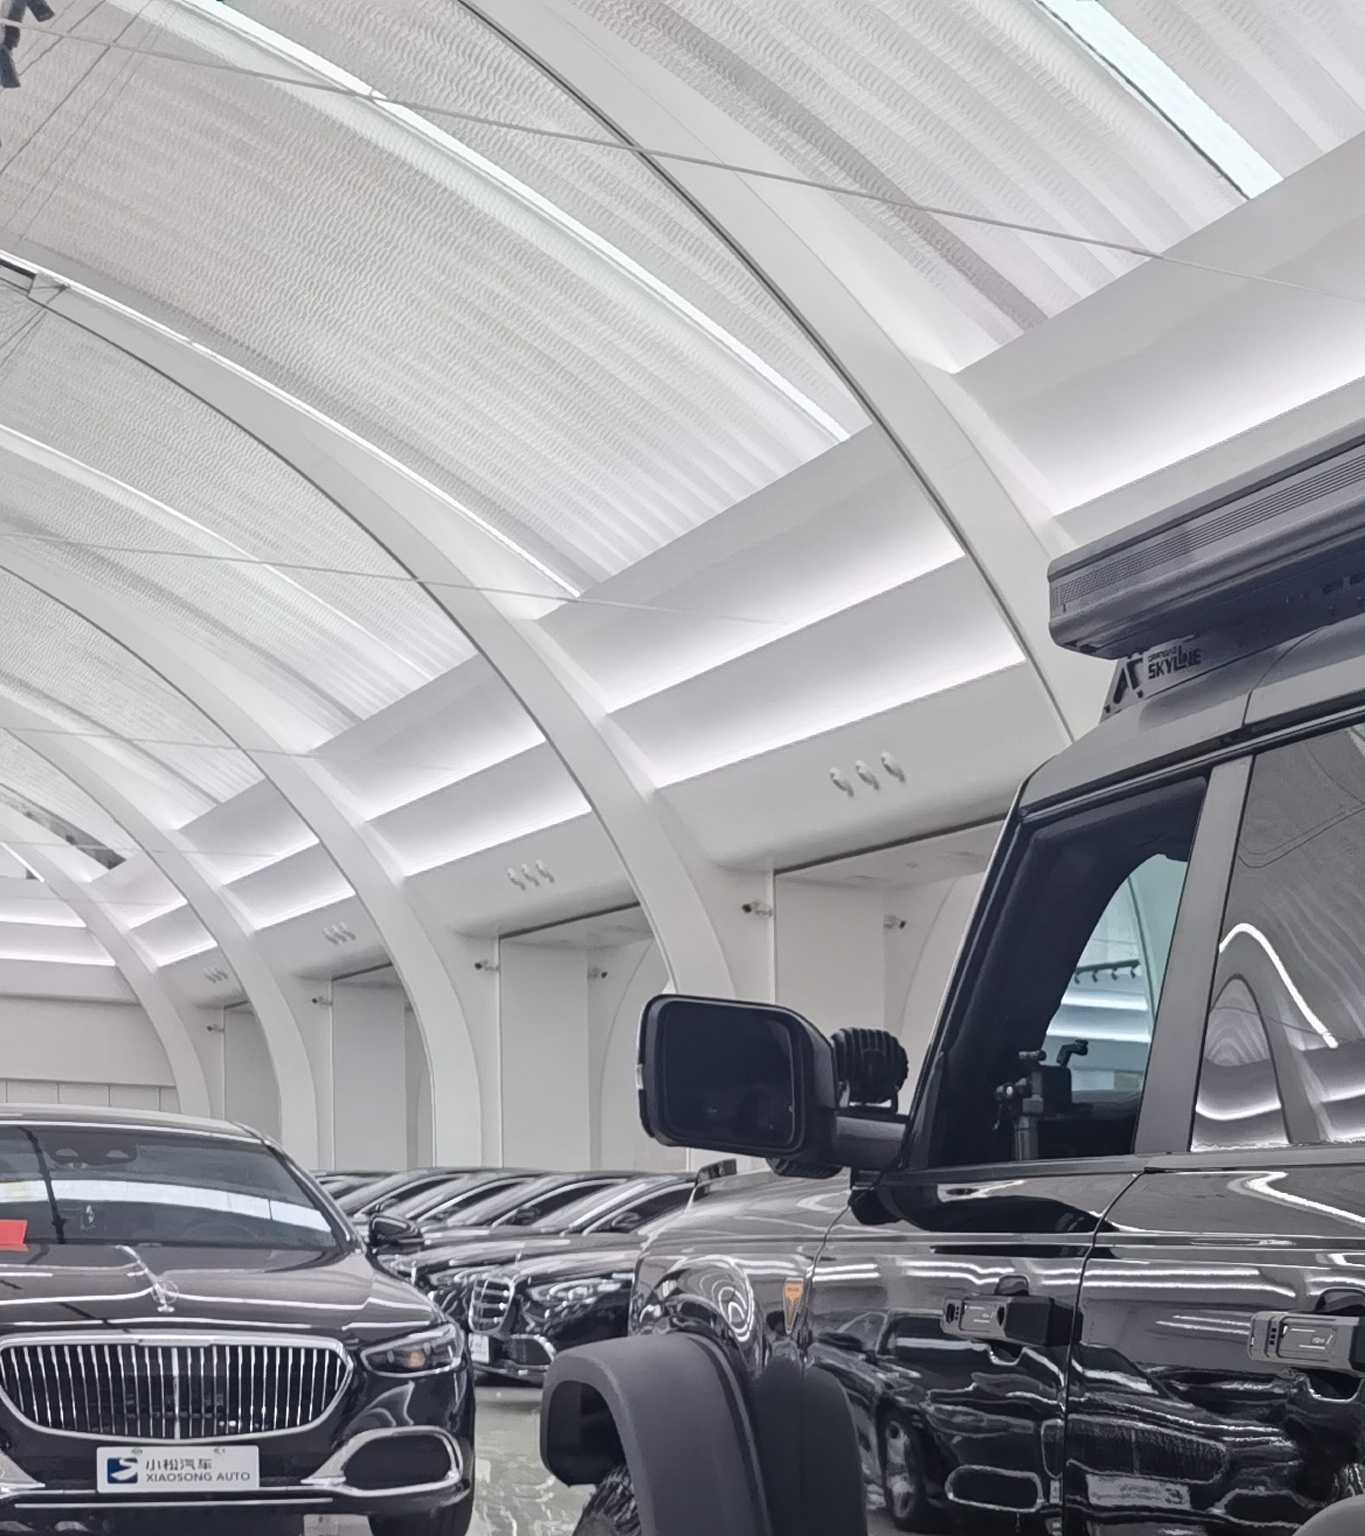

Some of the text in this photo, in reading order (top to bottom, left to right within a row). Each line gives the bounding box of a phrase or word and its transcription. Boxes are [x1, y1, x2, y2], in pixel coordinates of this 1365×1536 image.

[146, 1458, 212, 1471] 小松汽车
[146, 1471, 251, 1482] XIAOSONG AUTO
